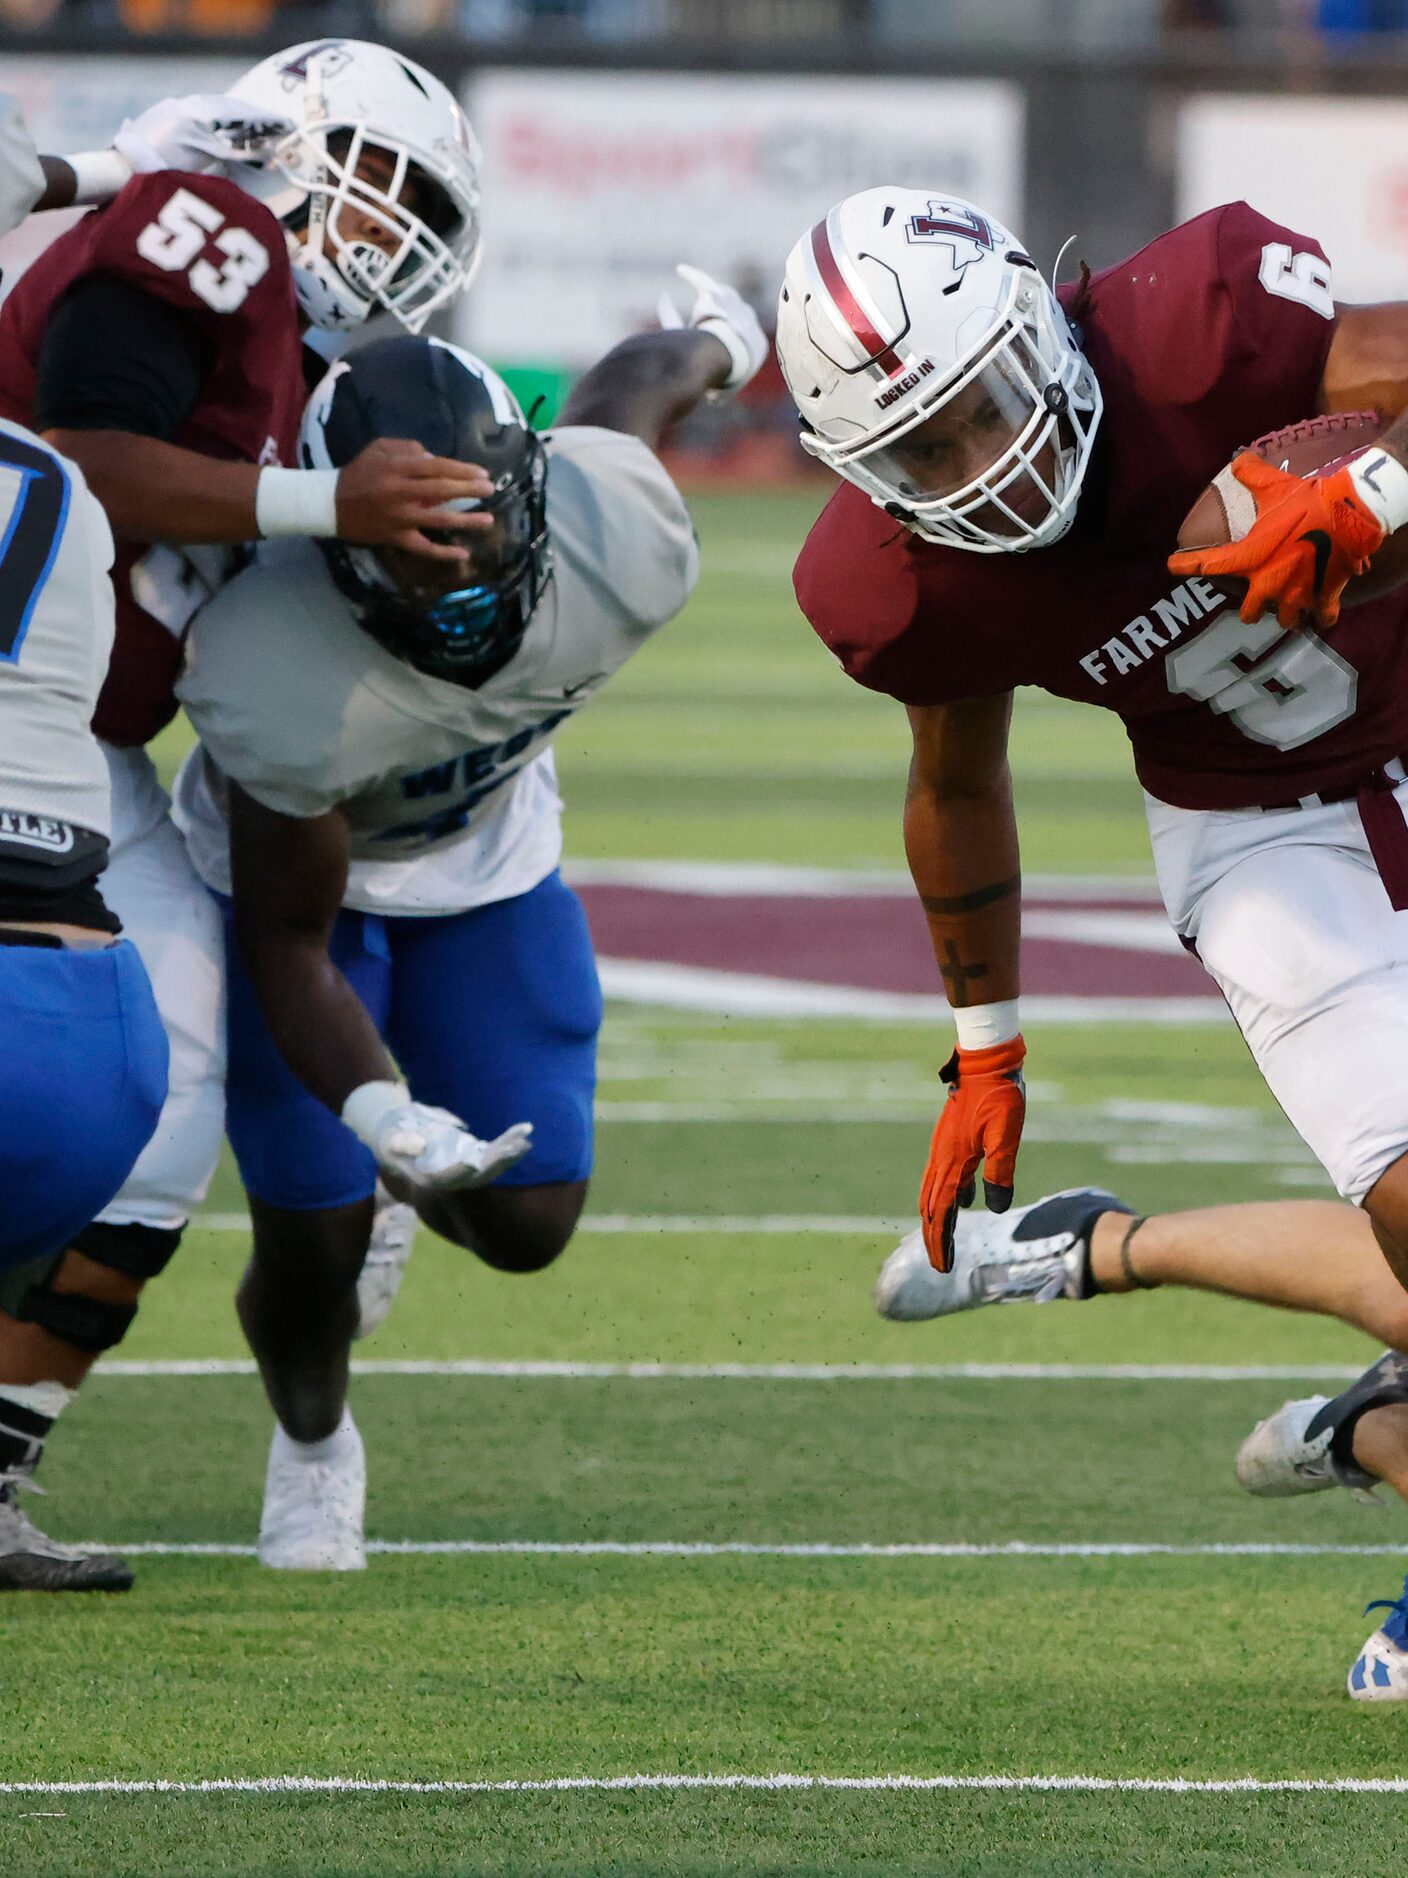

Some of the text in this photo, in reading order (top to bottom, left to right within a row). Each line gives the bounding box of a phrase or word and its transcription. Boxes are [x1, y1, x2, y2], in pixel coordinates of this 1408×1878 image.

[136, 187, 271, 314] 53
[1258, 242, 1335, 320] 6
[874, 358, 936, 410] LOCKED IN
[1359, 455, 1389, 501] L
[1165, 609, 1358, 752] 6
